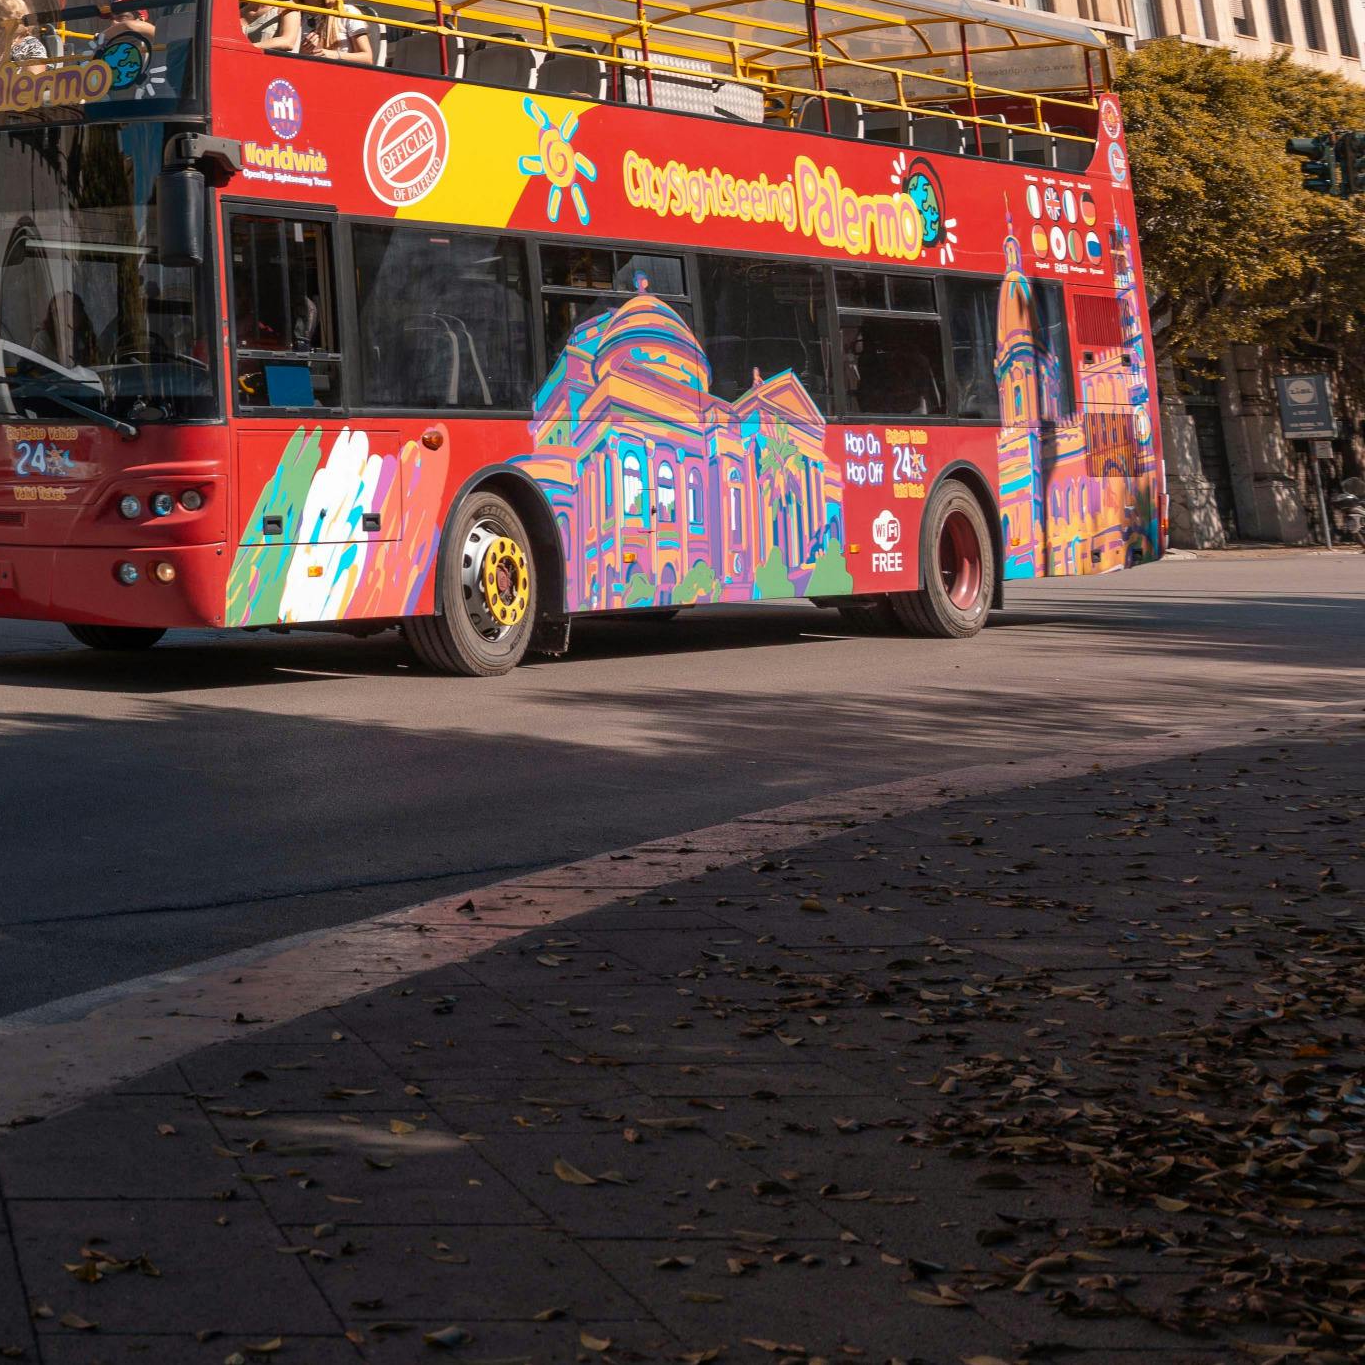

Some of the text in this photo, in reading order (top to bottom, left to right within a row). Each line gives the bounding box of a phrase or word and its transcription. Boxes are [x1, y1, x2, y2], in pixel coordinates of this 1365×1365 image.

[380, 99, 408, 125] TOUR
[244, 142, 328, 172] Worldwide
[381, 121, 433, 173] OFFICIAL
[274, 172, 313, 186] Sightseeing
[313, 177, 332, 187] Tours
[393, 156, 441, 201] OF PALERMO
[794, 155, 922, 260] Palermo
[844, 432, 881, 456] Hop On
[846, 461, 884, 485] Hop Off
[892, 446, 912, 481] 24
[871, 552, 903, 573] FREE
